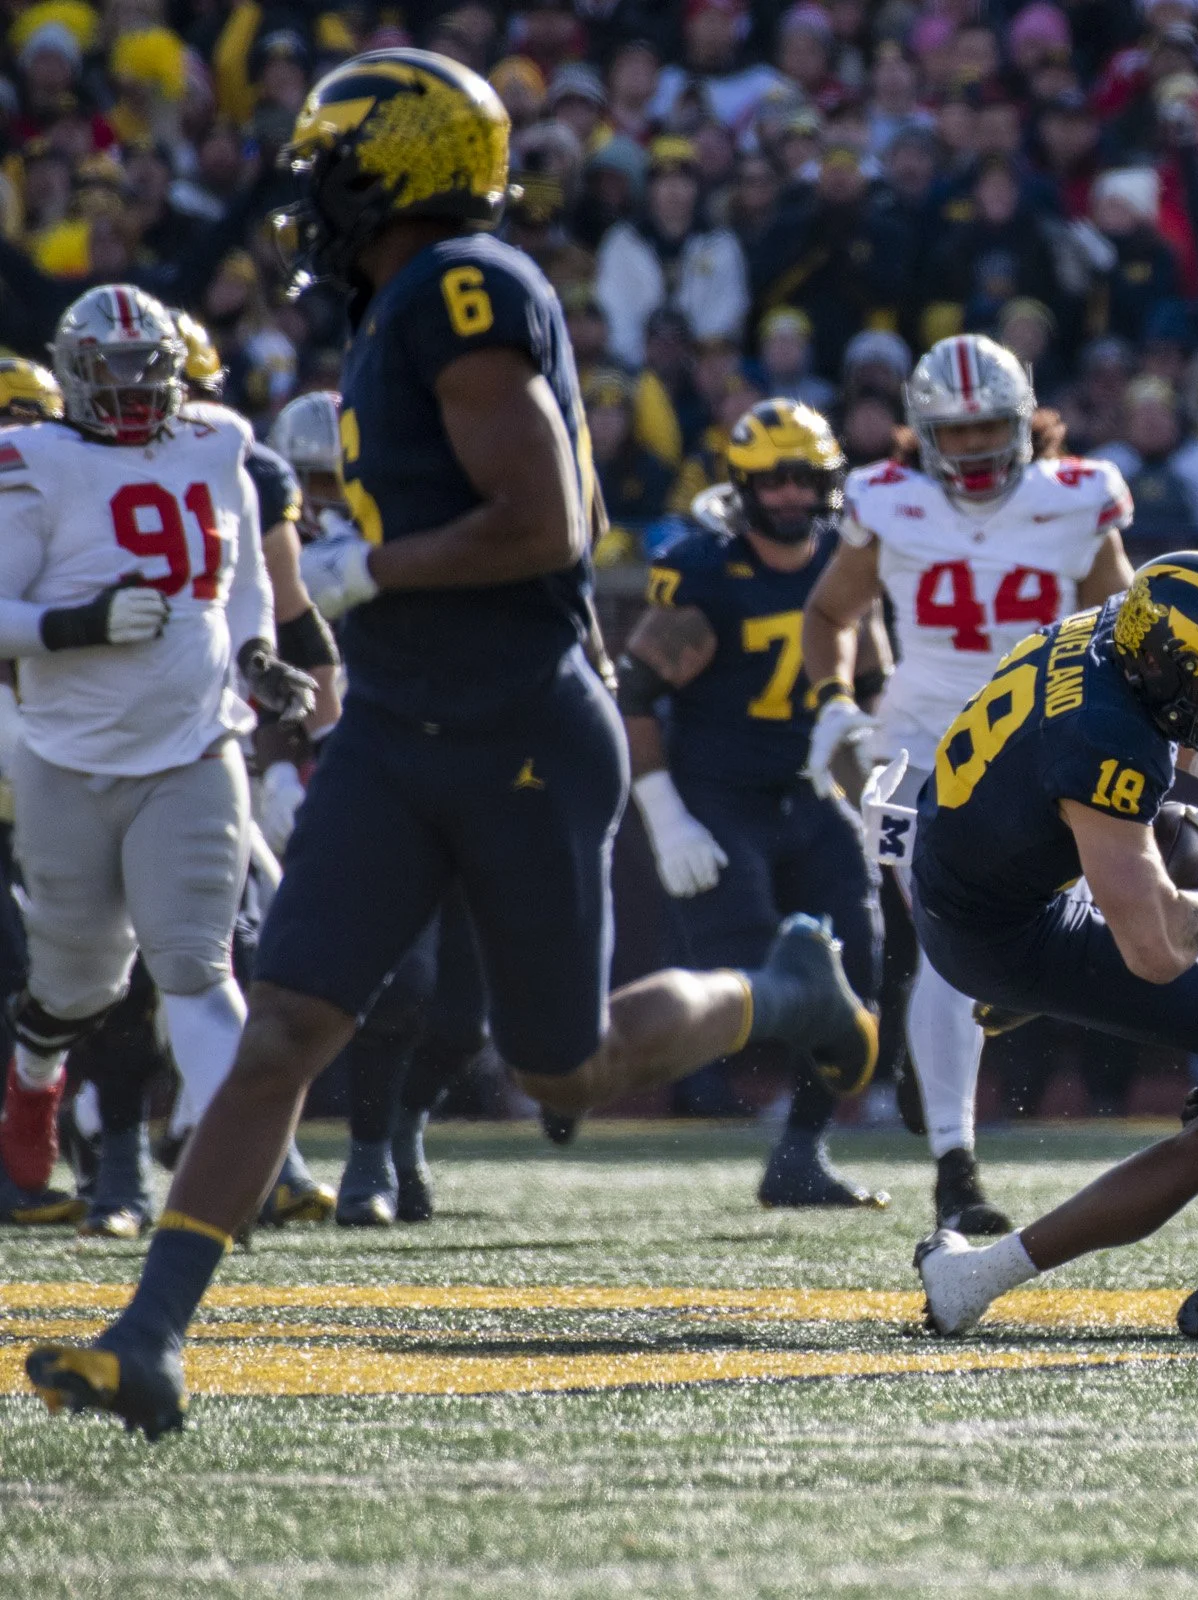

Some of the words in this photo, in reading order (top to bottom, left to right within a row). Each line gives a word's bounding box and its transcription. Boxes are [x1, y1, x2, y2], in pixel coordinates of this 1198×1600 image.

[441, 265, 494, 337] 6
[110, 482, 222, 599] 91
[915, 558, 1061, 652] 44
[1091, 758, 1146, 815] 18
[878, 814, 911, 858] M
